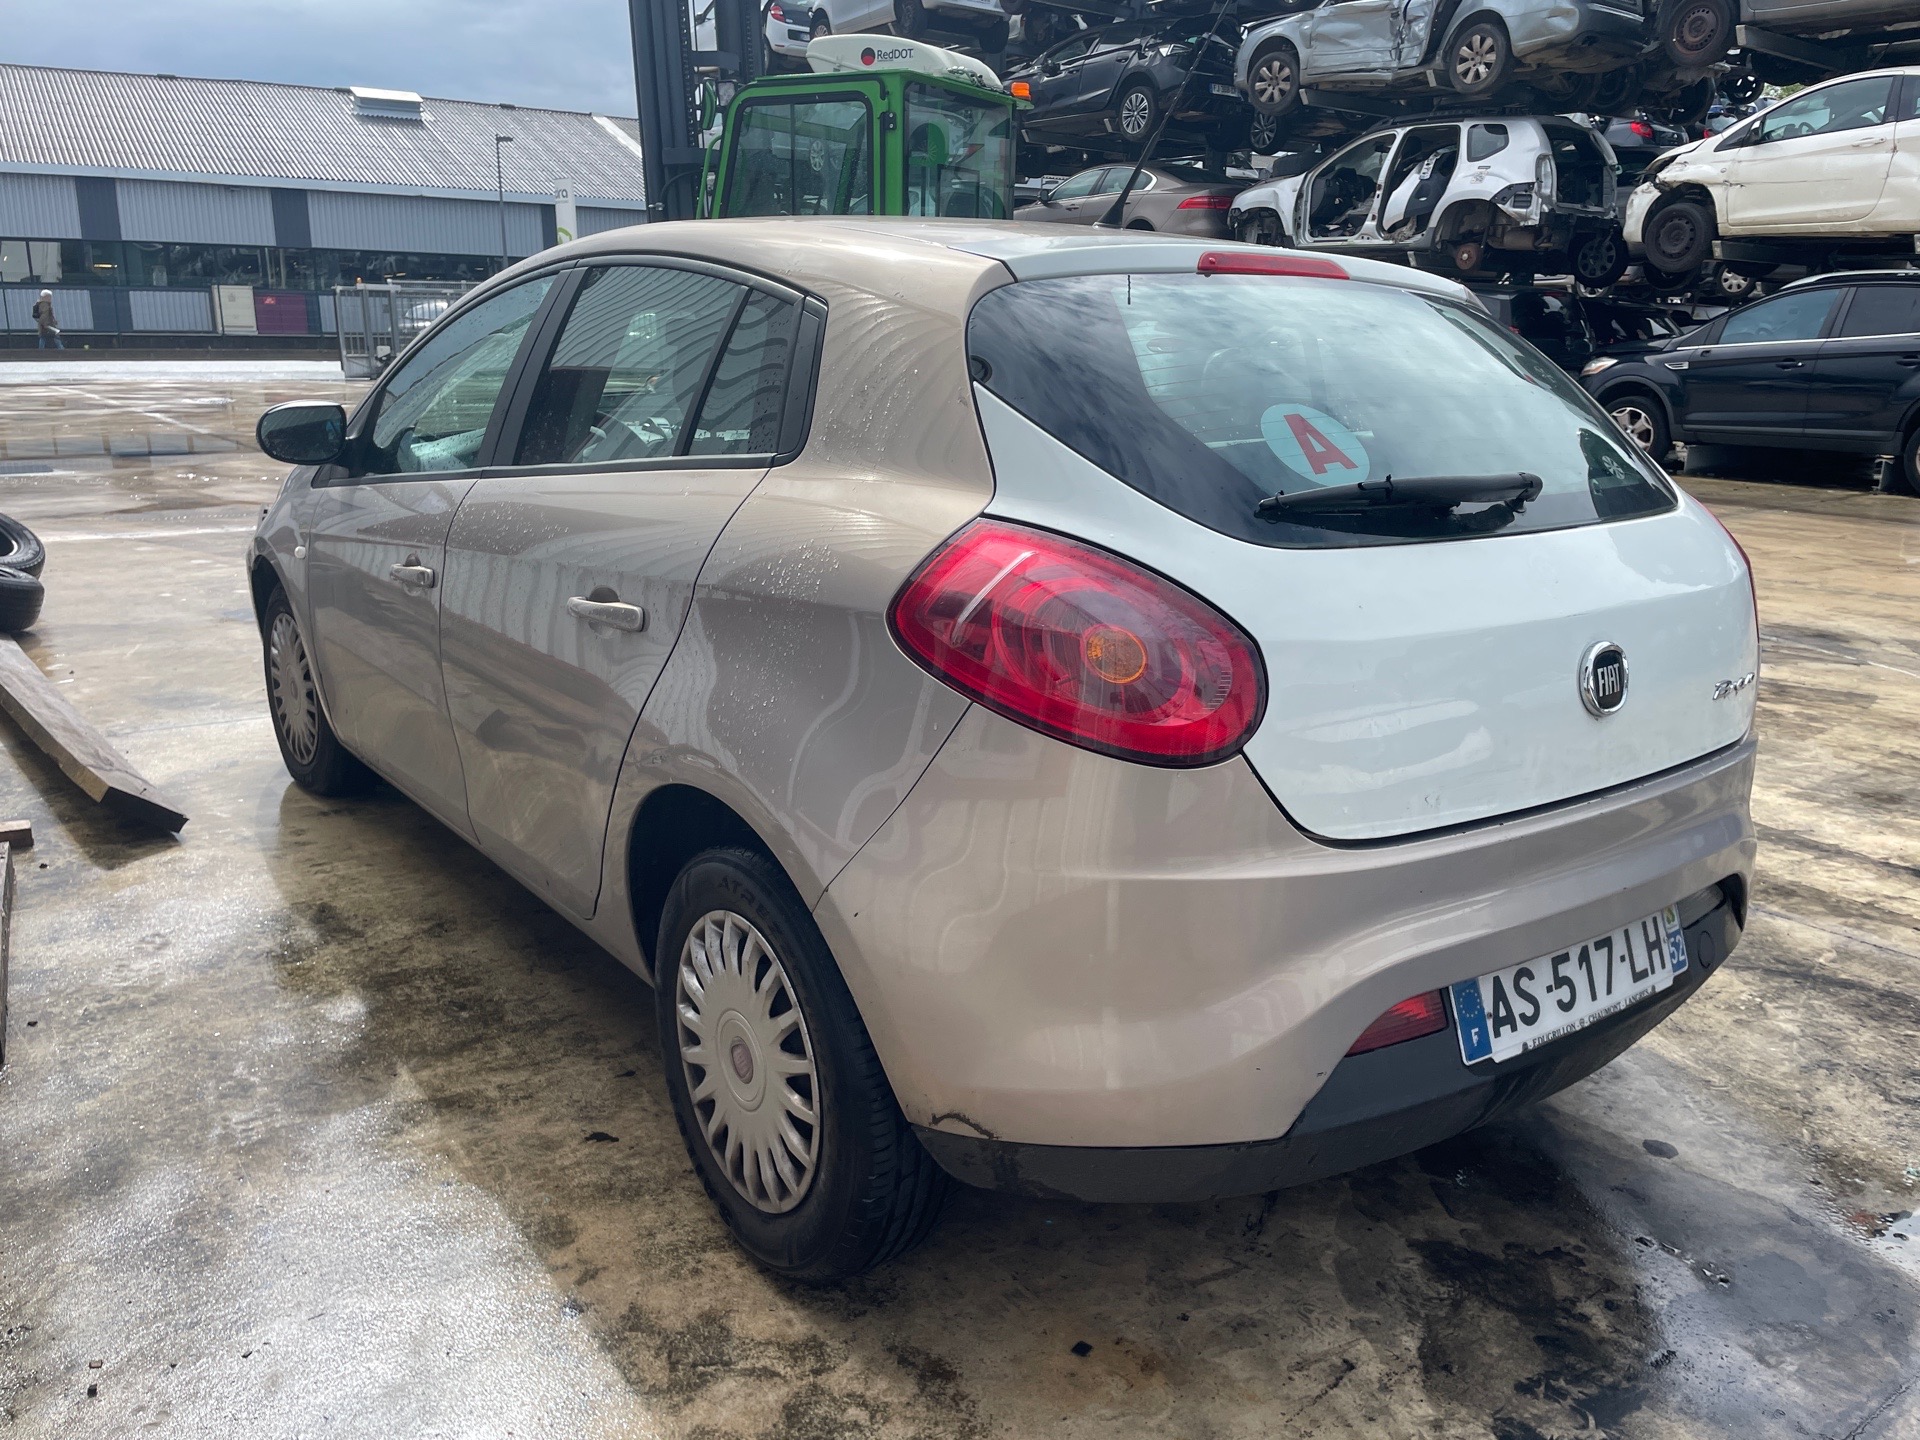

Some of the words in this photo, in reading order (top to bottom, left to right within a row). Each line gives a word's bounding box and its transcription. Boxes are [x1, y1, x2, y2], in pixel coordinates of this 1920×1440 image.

[877, 49, 913, 60] RedDOT
[1283, 413, 1359, 475] A
[1597, 662, 1620, 697] FIAT
[1668, 934, 1686, 964] 52
[1492, 916, 1666, 1039] AS-517-LH
[1470, 1027, 1479, 1046] F
